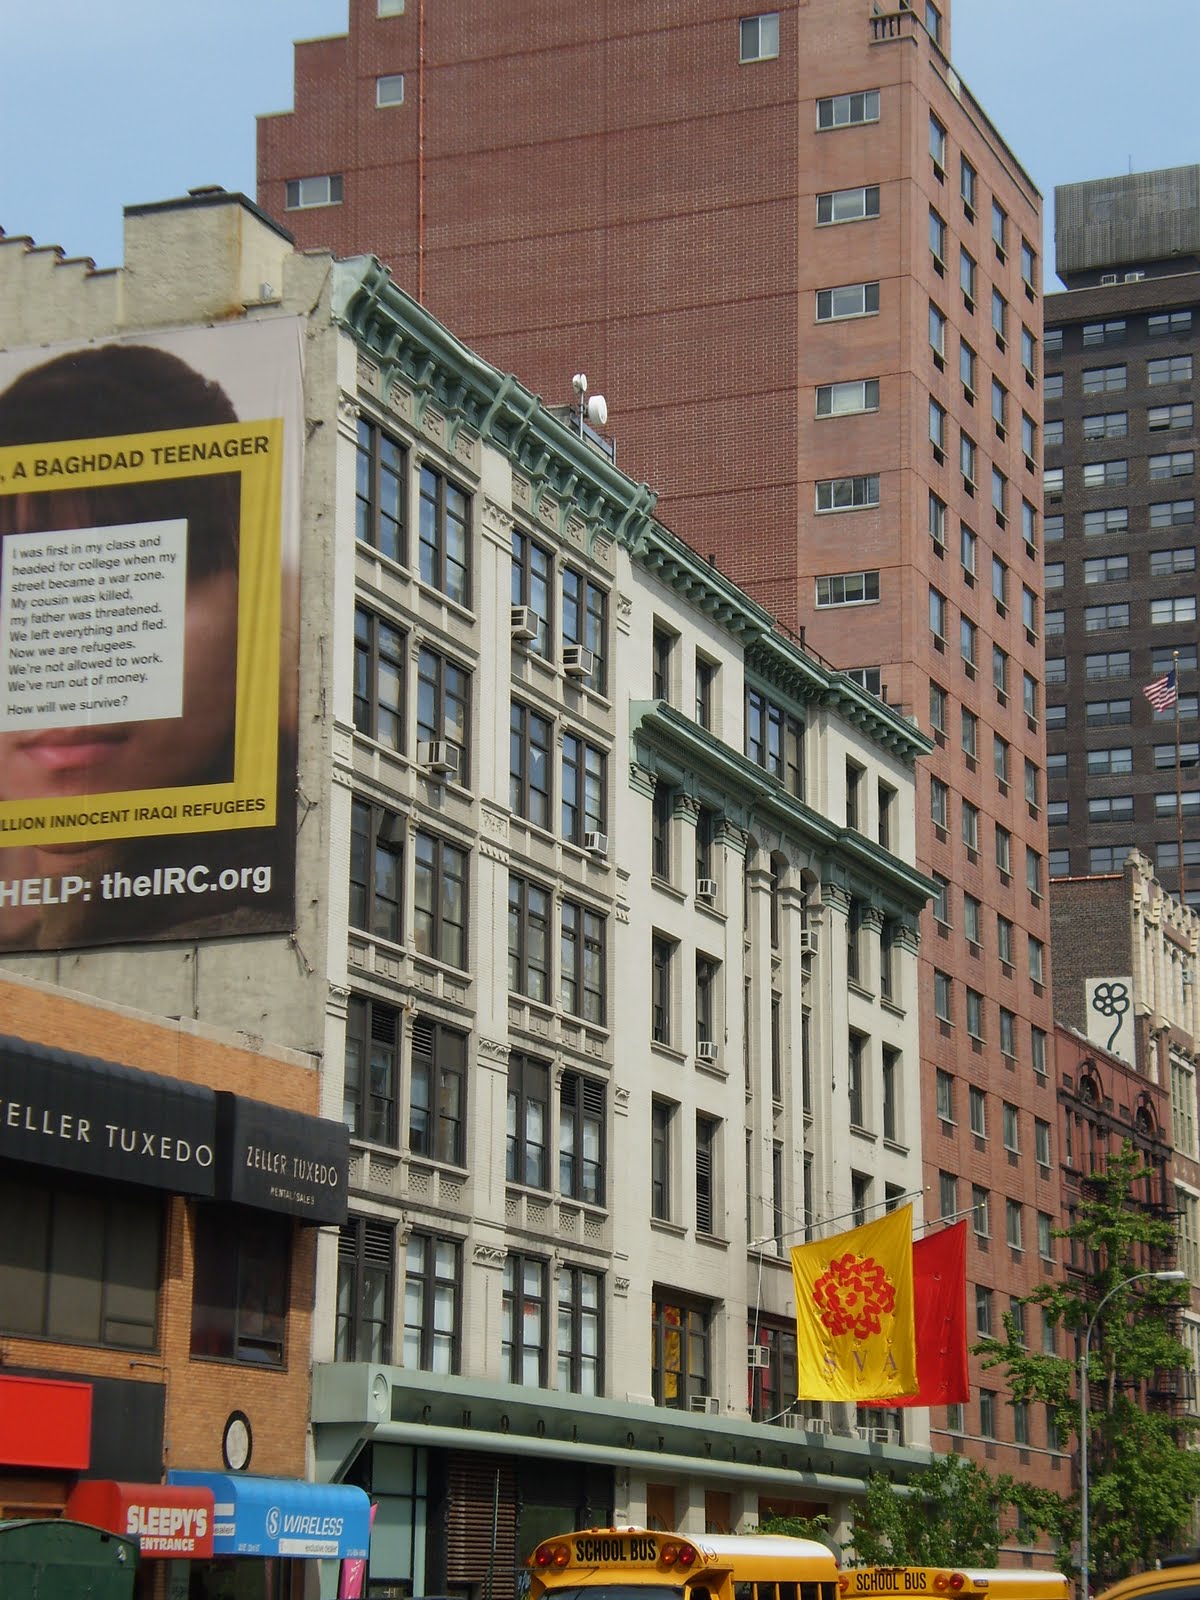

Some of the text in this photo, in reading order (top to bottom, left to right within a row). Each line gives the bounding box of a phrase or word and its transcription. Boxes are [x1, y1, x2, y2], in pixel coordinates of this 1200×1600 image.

[12, 436, 269, 479] A BAGHDAD TEENAGER
[20, 549, 43, 558] was
[46, 544, 68, 556] first
[72, 544, 82, 554] in
[86, 543, 102, 555] my
[106, 540, 135, 551] class
[139, 536, 161, 547] and
[12, 552, 176, 575] headed for college when my
[12, 571, 165, 592] street became a war zone.
[11, 598, 26, 610] My
[31, 595, 68, 607] cousin
[73, 593, 95, 603] was
[10, 604, 161, 627] my father was threatened.
[10, 619, 166, 642] We left everything and fled.
[9, 640, 136, 658] Now we are refugees.
[9, 653, 163, 675] We're not allowed to work.
[8, 673, 148, 692] We've run out of money.
[8, 695, 128, 715] How will we survive?
[0, 799, 265, 831] LLION INNOCENT IRAQI REFUGEES
[0, 866, 271, 906] HELP: theIRC.org
[0, 1100, 213, 1167] ELLER TUXEDO
[247, 1146, 337, 1186] ZELLER TUXEDO
[127, 1505, 207, 1537] SLEEPY'S
[215, 1526, 234, 1534] ealer
[283, 1514, 344, 1536] WIRELESS
[140, 1538, 195, 1551] ENTRANCE
[576, 1538, 656, 1562] SCHOOL BUS
[857, 1572, 926, 1590] SCHOOL BUS
